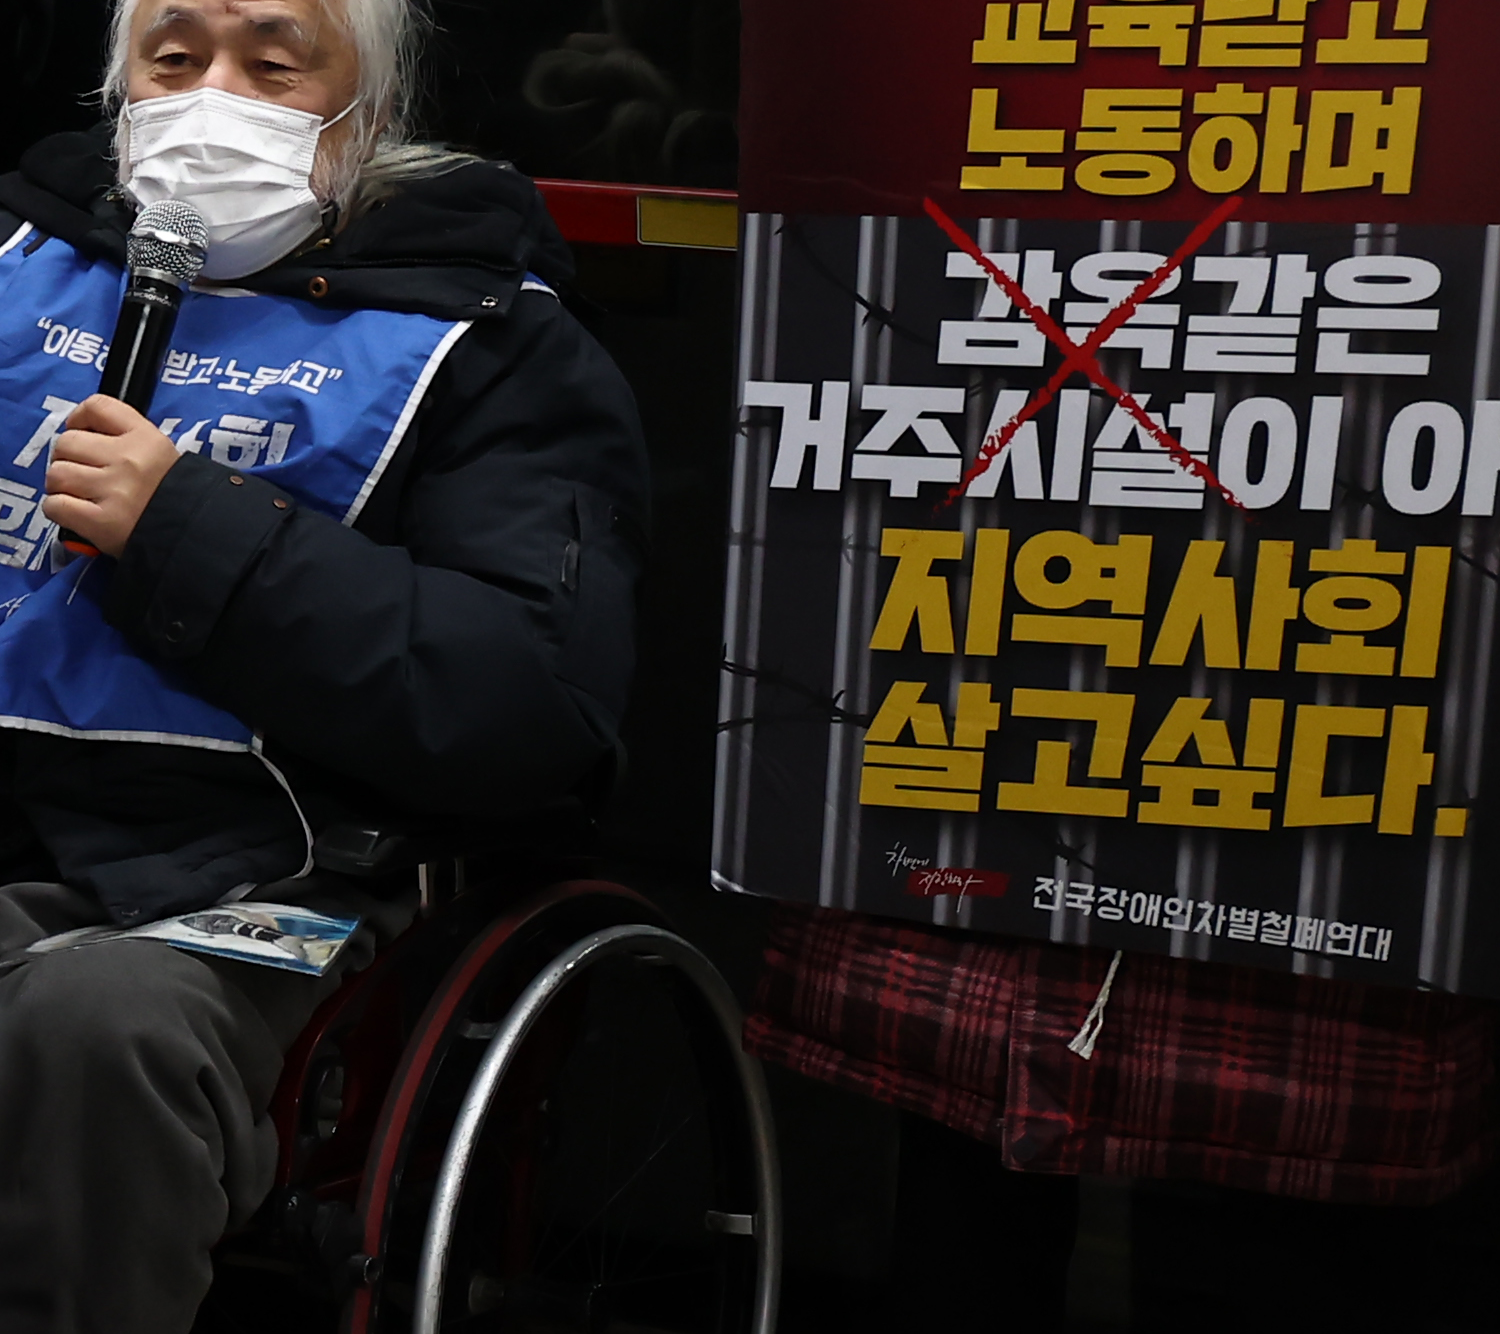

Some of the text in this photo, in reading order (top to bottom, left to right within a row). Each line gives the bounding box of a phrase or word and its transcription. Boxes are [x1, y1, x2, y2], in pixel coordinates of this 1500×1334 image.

[959, 81, 1422, 197] 노동하며
[936, 249, 1442, 376] 감옥같은
[741, 380, 1343, 511] 거주시설이
[869, 526, 1453, 679] 지역사회
[859, 678, 1467, 838] 살고싶다.
[1033, 875, 1394, 963] 전국장애인차별철폐연대
